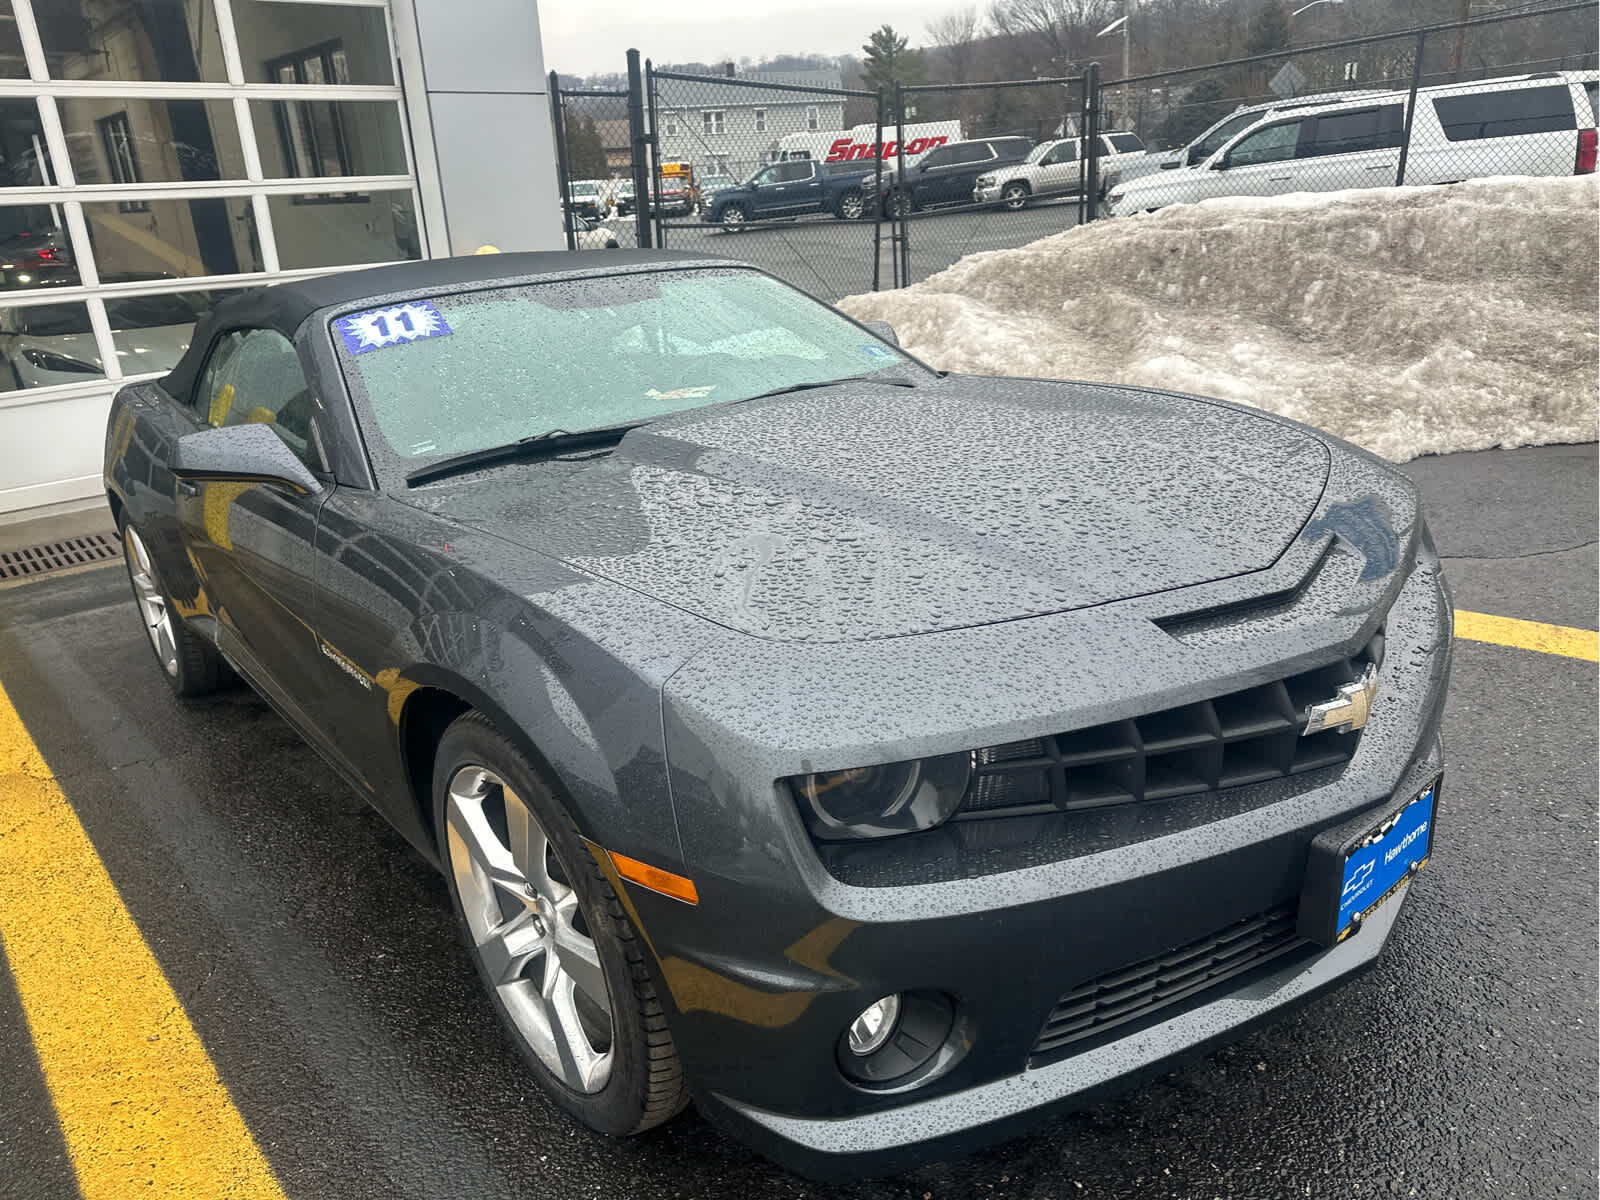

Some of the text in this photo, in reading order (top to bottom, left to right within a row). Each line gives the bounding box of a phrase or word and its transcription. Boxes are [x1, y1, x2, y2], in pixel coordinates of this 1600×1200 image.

[825, 135, 948, 162] Snap-on
[371, 311, 415, 337] 11
[1384, 821, 1428, 866] Hawthorne
